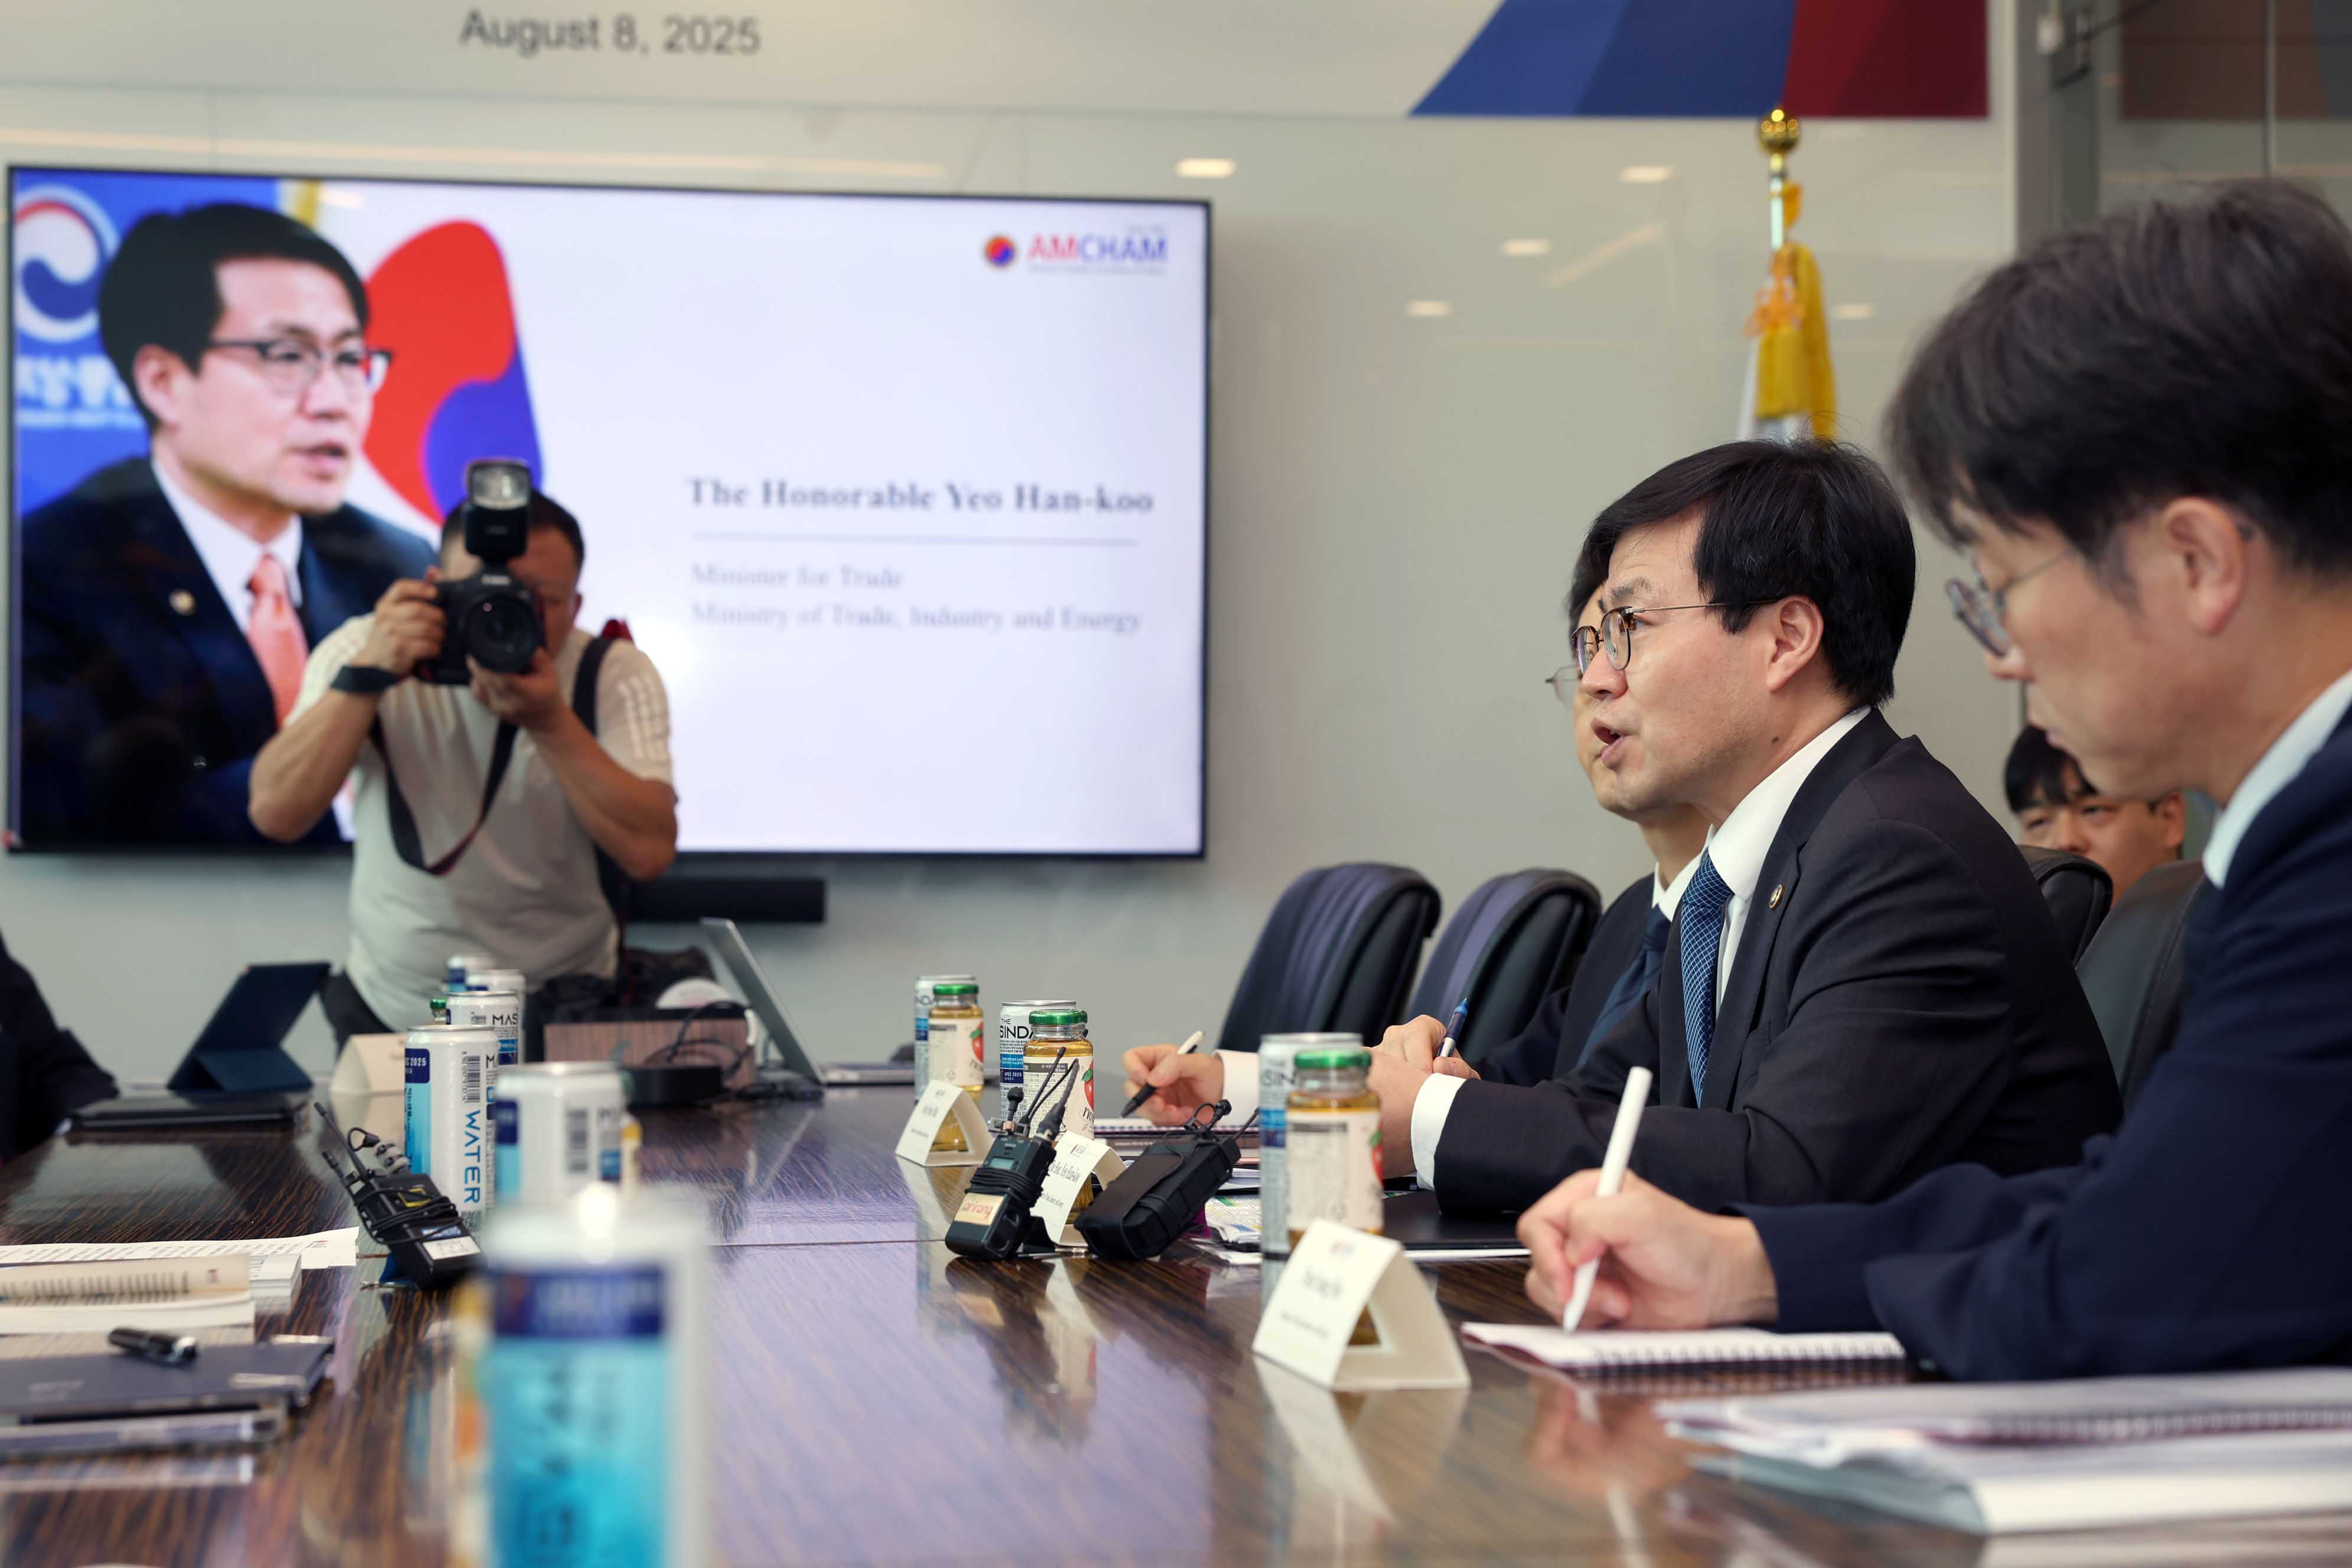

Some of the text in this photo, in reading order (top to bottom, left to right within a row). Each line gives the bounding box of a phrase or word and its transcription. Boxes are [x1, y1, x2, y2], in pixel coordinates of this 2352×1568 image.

[459, 7, 762, 58] August 8, 2025
[1028, 234, 1168, 263] AMCHAM
[687, 478, 1155, 514] The Honorable Yeo Han-koo
[797, 564, 829, 589] for
[839, 565, 903, 589] Trade
[690, 603, 789, 629] Ministry
[798, 603, 822, 626] of
[910, 606, 1004, 633] Industry
[1013, 607, 1053, 630] and
[1061, 609, 1142, 635] Energy
[464, 1110, 481, 1203] WATER
